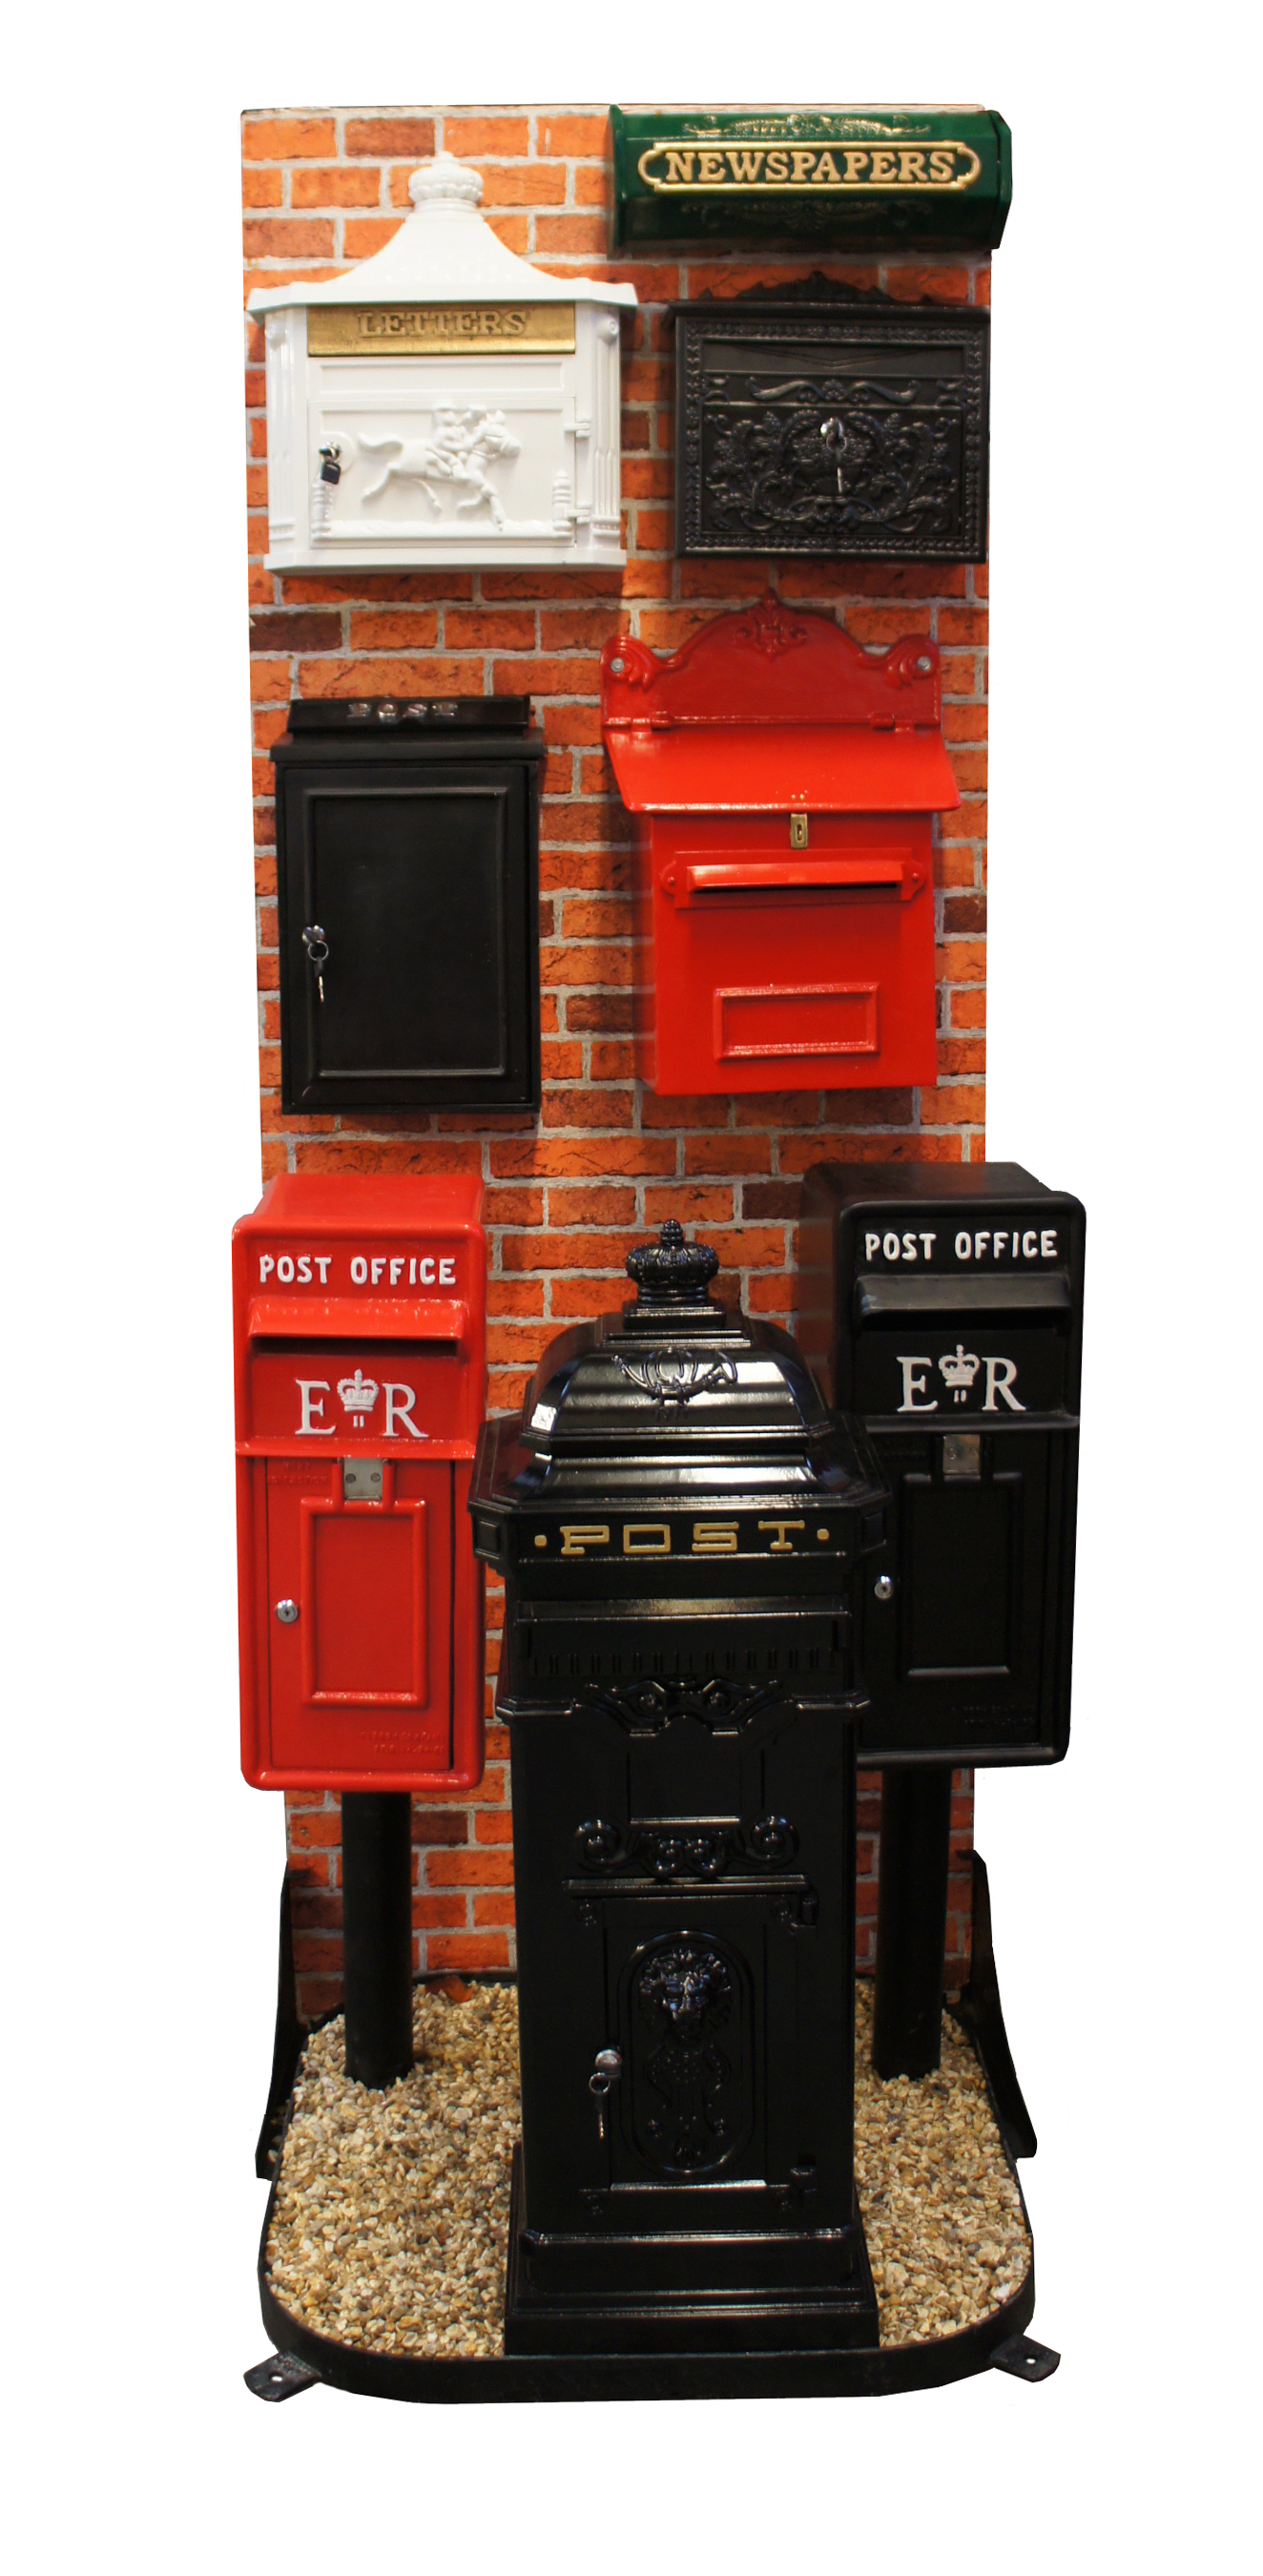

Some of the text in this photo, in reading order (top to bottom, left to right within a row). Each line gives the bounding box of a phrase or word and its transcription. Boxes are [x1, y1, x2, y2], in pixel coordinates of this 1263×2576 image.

[665, 150, 956, 183] NEWSPAPERS
[357, 310, 528, 338] LETTERS
[347, 701, 459, 723] POST
[865, 1229, 1059, 1261] POST OFFICE
[259, 1255, 456, 1285] POST OFFICE
[559, 1519, 805, 1555] POST
